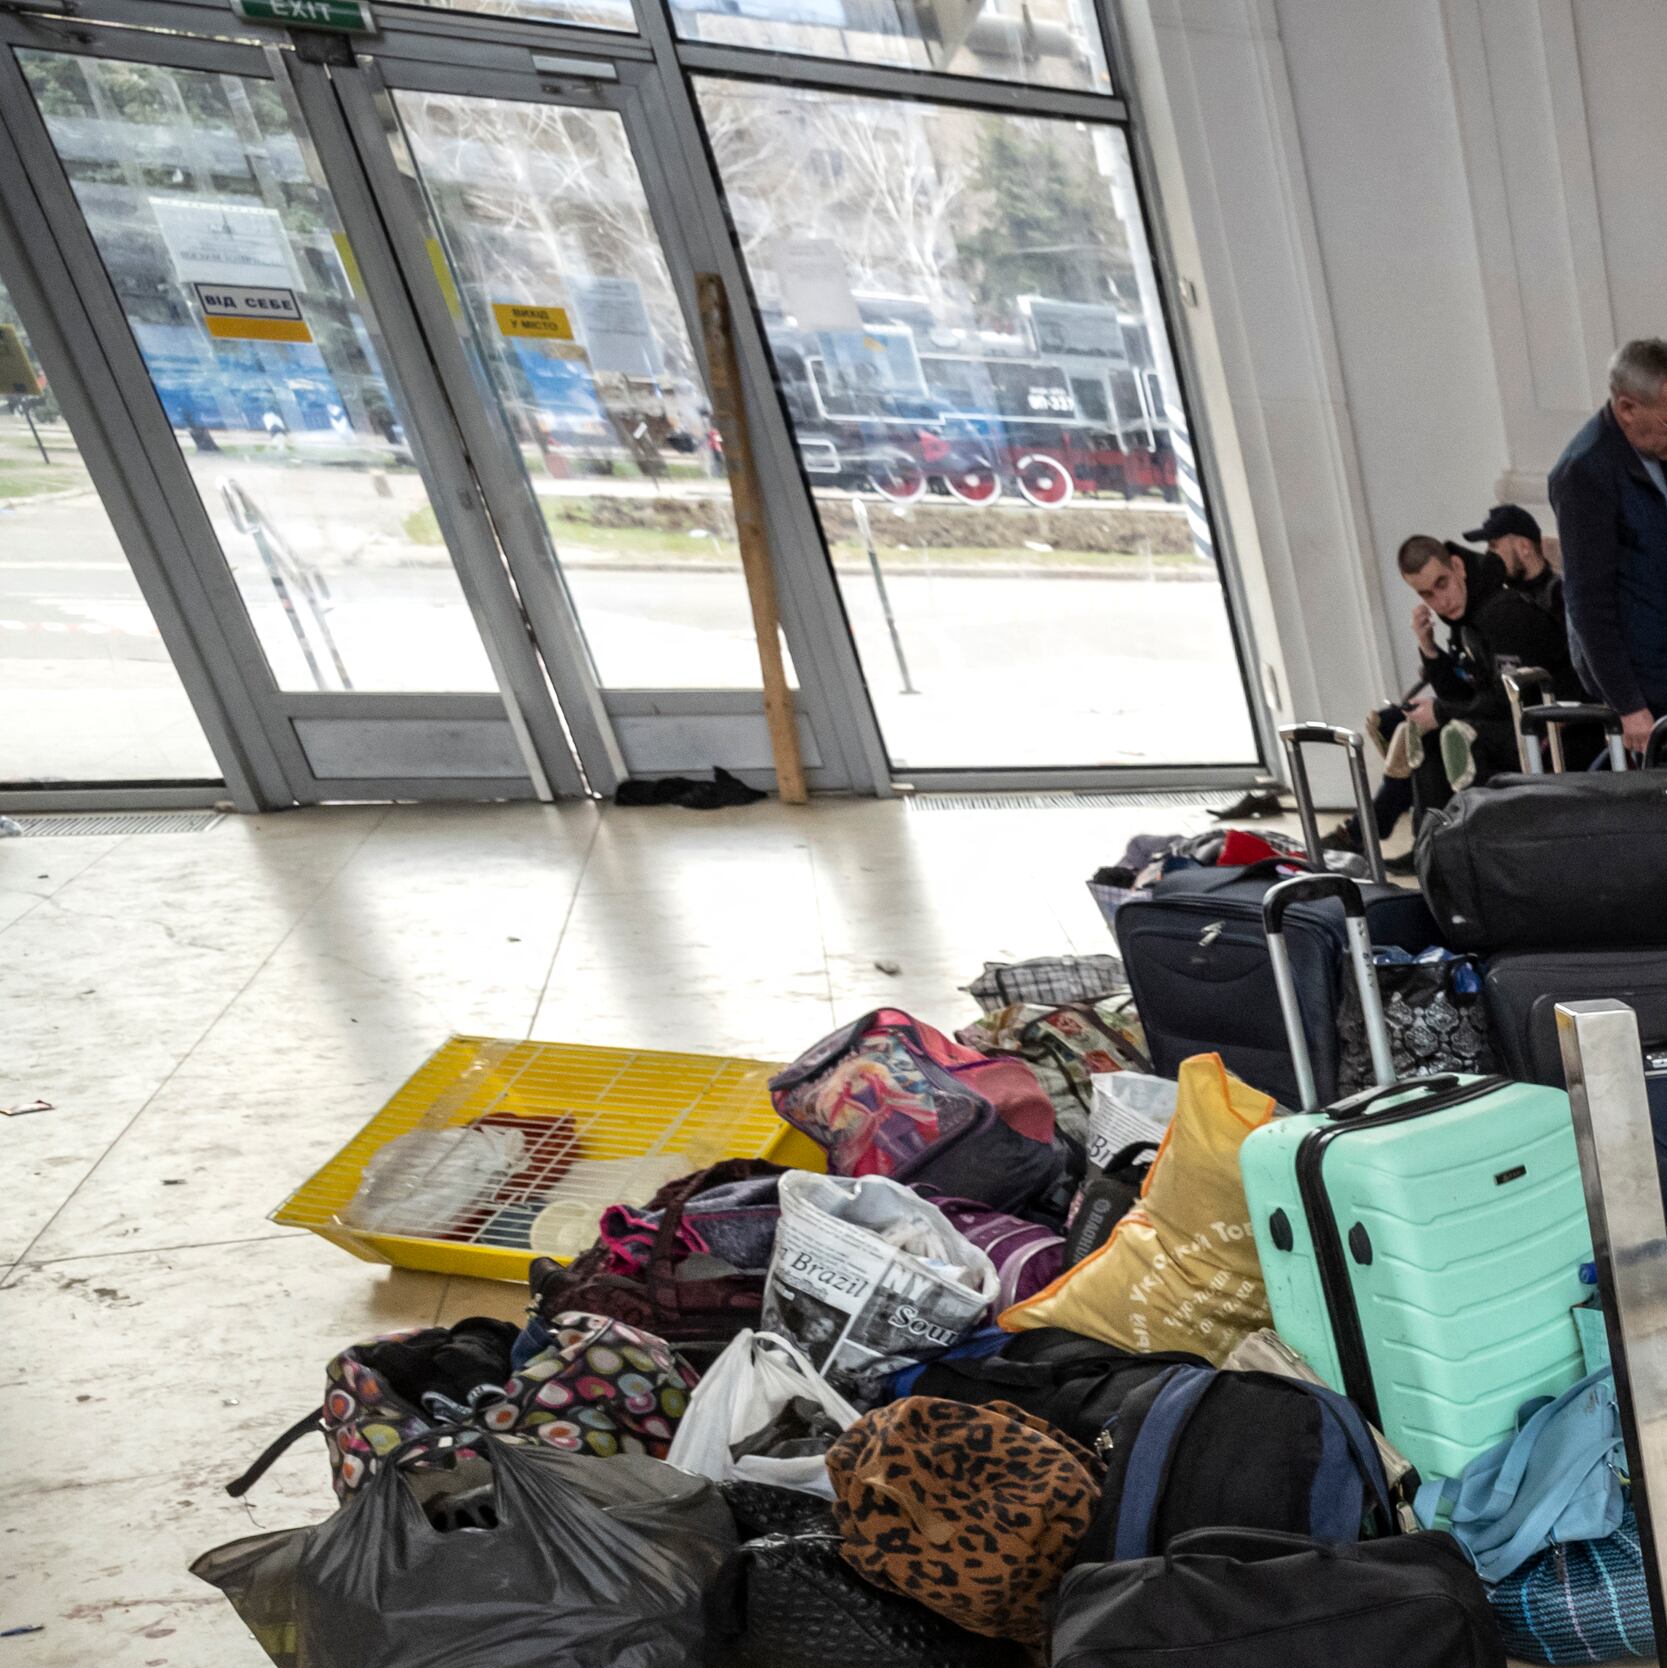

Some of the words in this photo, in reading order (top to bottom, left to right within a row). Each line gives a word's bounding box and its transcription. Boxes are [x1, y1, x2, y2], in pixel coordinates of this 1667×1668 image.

[270, 0, 331, 22] EXIT
[204, 294, 237, 309] ВІД
[245, 297, 293, 311] СЕБЕ
[790, 1251, 870, 1299] Brazil
